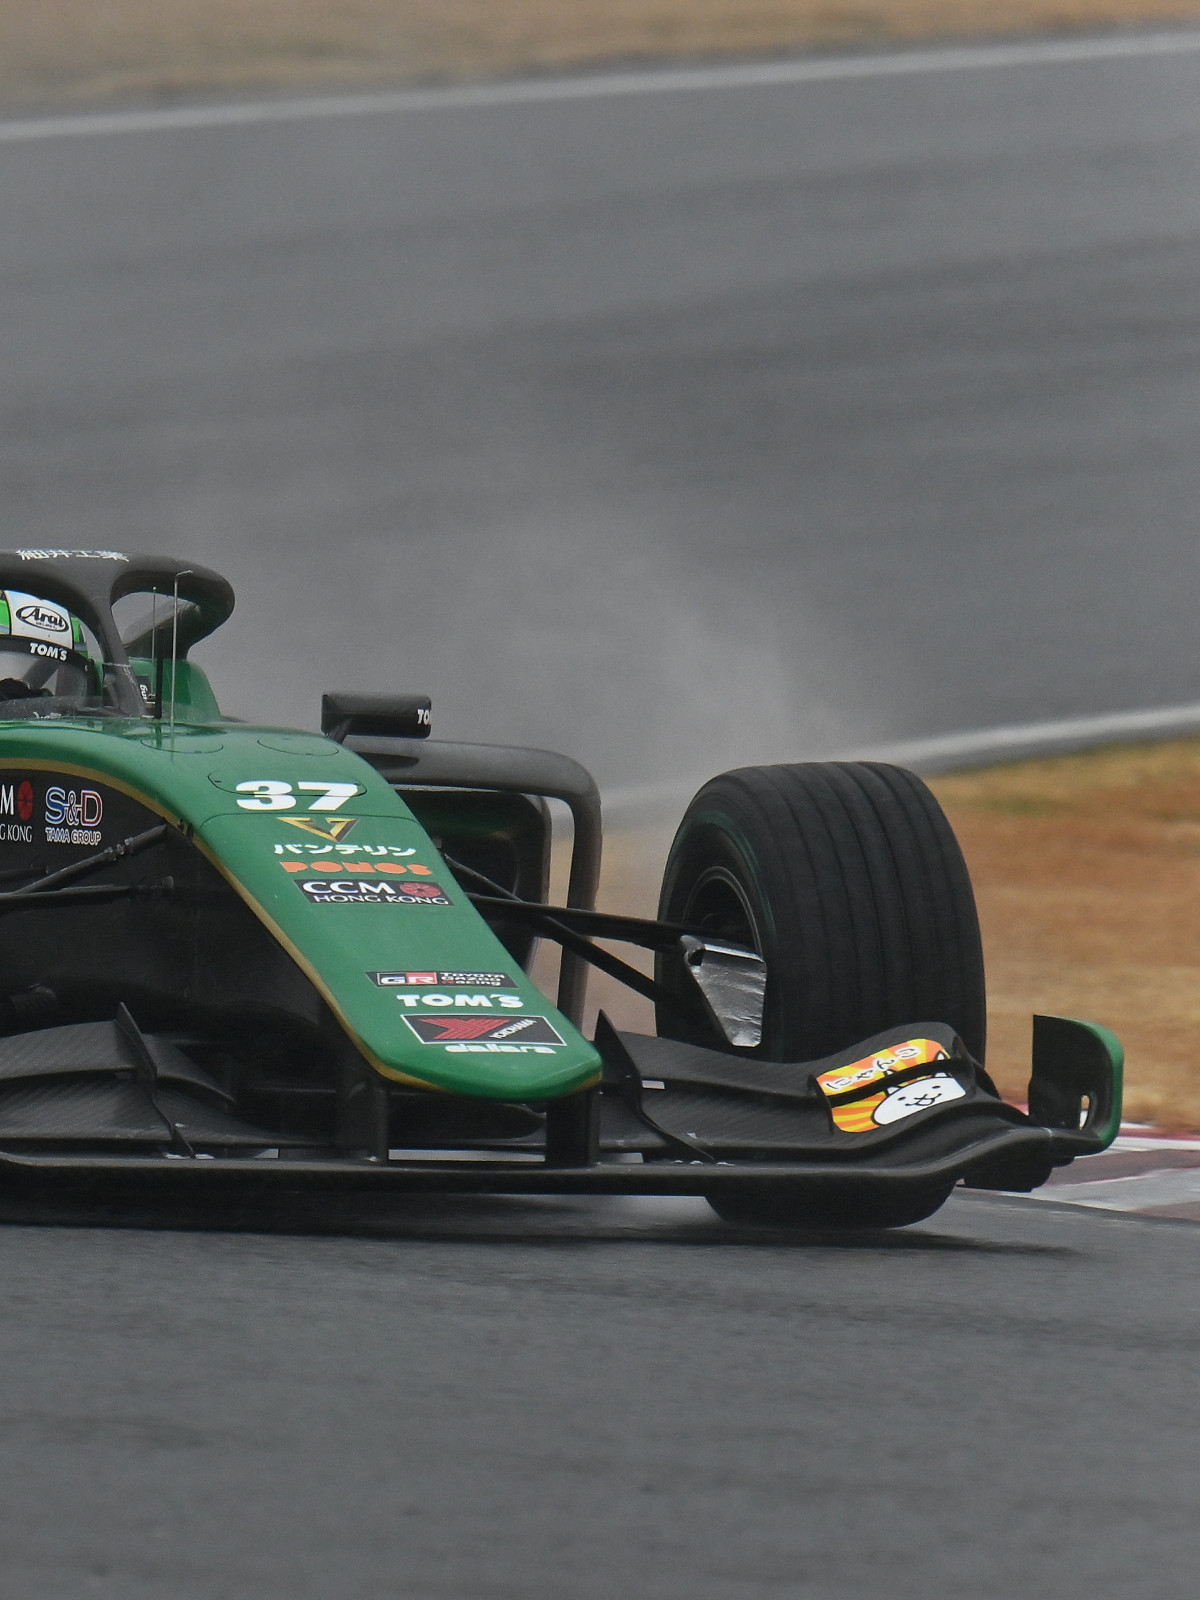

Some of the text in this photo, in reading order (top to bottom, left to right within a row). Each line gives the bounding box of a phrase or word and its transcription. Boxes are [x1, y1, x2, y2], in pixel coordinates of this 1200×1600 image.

[21, 607, 64, 628] Arai
[29, 642, 68, 661] TOM'S
[417, 709, 432, 725] TO
[235, 780, 358, 811] 37
[45, 786, 103, 827] S&D
[7, 824, 33, 843] KONG
[45, 827, 102, 846] TAMA GROUP
[273, 843, 417, 857] バンテリン
[302, 881, 397, 895] CCM
[314, 894, 449, 905] HONG KONG
[380, 976, 436, 985] GR
[396, 994, 524, 1008] TOM'S
[825, 1048, 919, 1090] にゃんこ
